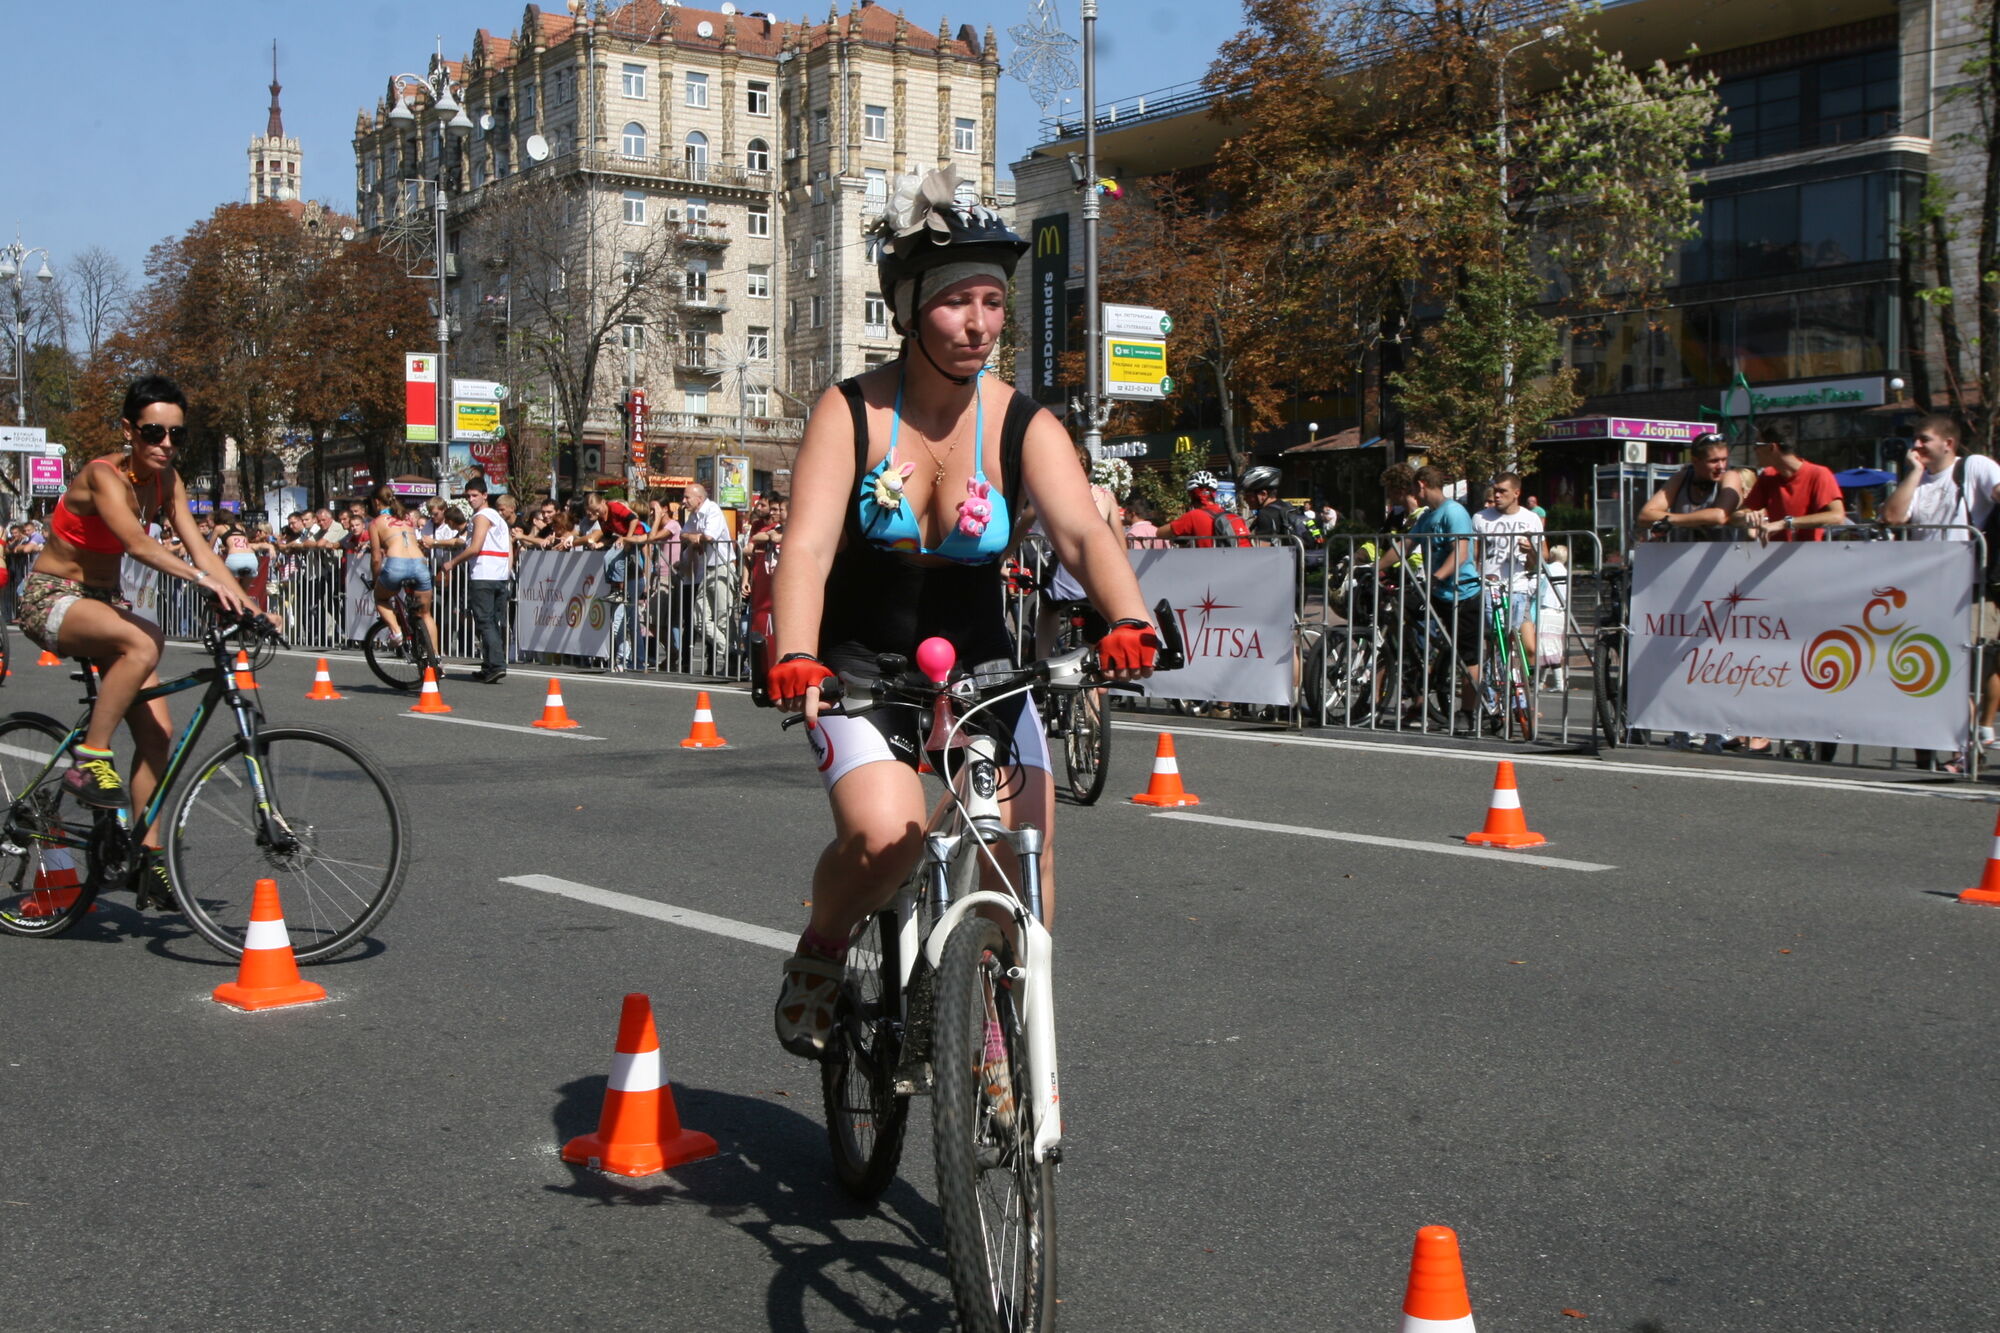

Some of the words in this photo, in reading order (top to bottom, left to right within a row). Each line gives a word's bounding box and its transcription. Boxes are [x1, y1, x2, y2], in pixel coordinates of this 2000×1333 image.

[1043, 271, 1054, 387] McDonald's
[1100, 441, 1147, 459] onald's
[523, 581, 564, 604] MILAVITSA
[1174, 608, 1265, 666] VITSA
[1644, 600, 1792, 645] MILAVITSA
[1681, 647, 1793, 697] Velofest
